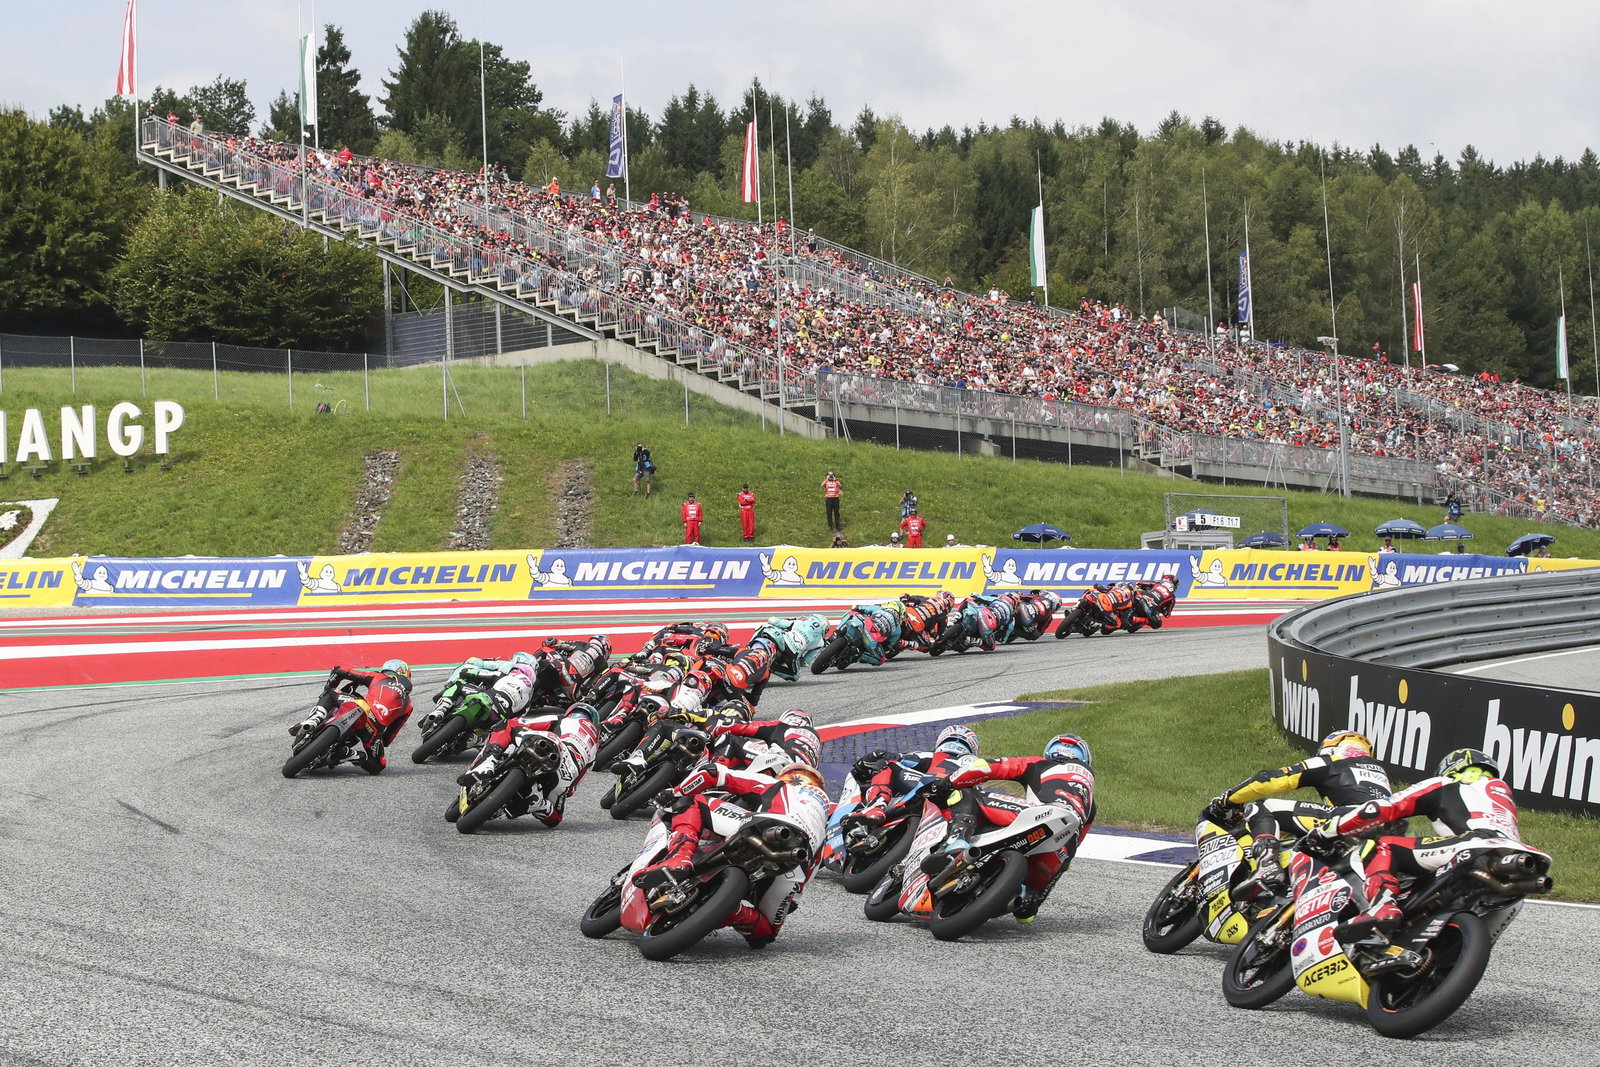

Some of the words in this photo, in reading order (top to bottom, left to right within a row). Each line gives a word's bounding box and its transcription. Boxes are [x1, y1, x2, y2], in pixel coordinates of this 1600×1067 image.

[1200, 514, 1206, 524] 5
[117, 569, 287, 590] MICHELIN
[343, 563, 517, 587] MICHELIN
[574, 560, 750, 582] MICHELIN
[806, 560, 978, 580] MICHELIN
[1023, 562, 1181, 582] MICHELIN
[1229, 562, 1366, 583] MICHELIN
[1281, 657, 1320, 743] bwin
[1347, 674, 1431, 771] bwin
[1482, 698, 1600, 804] bwin
